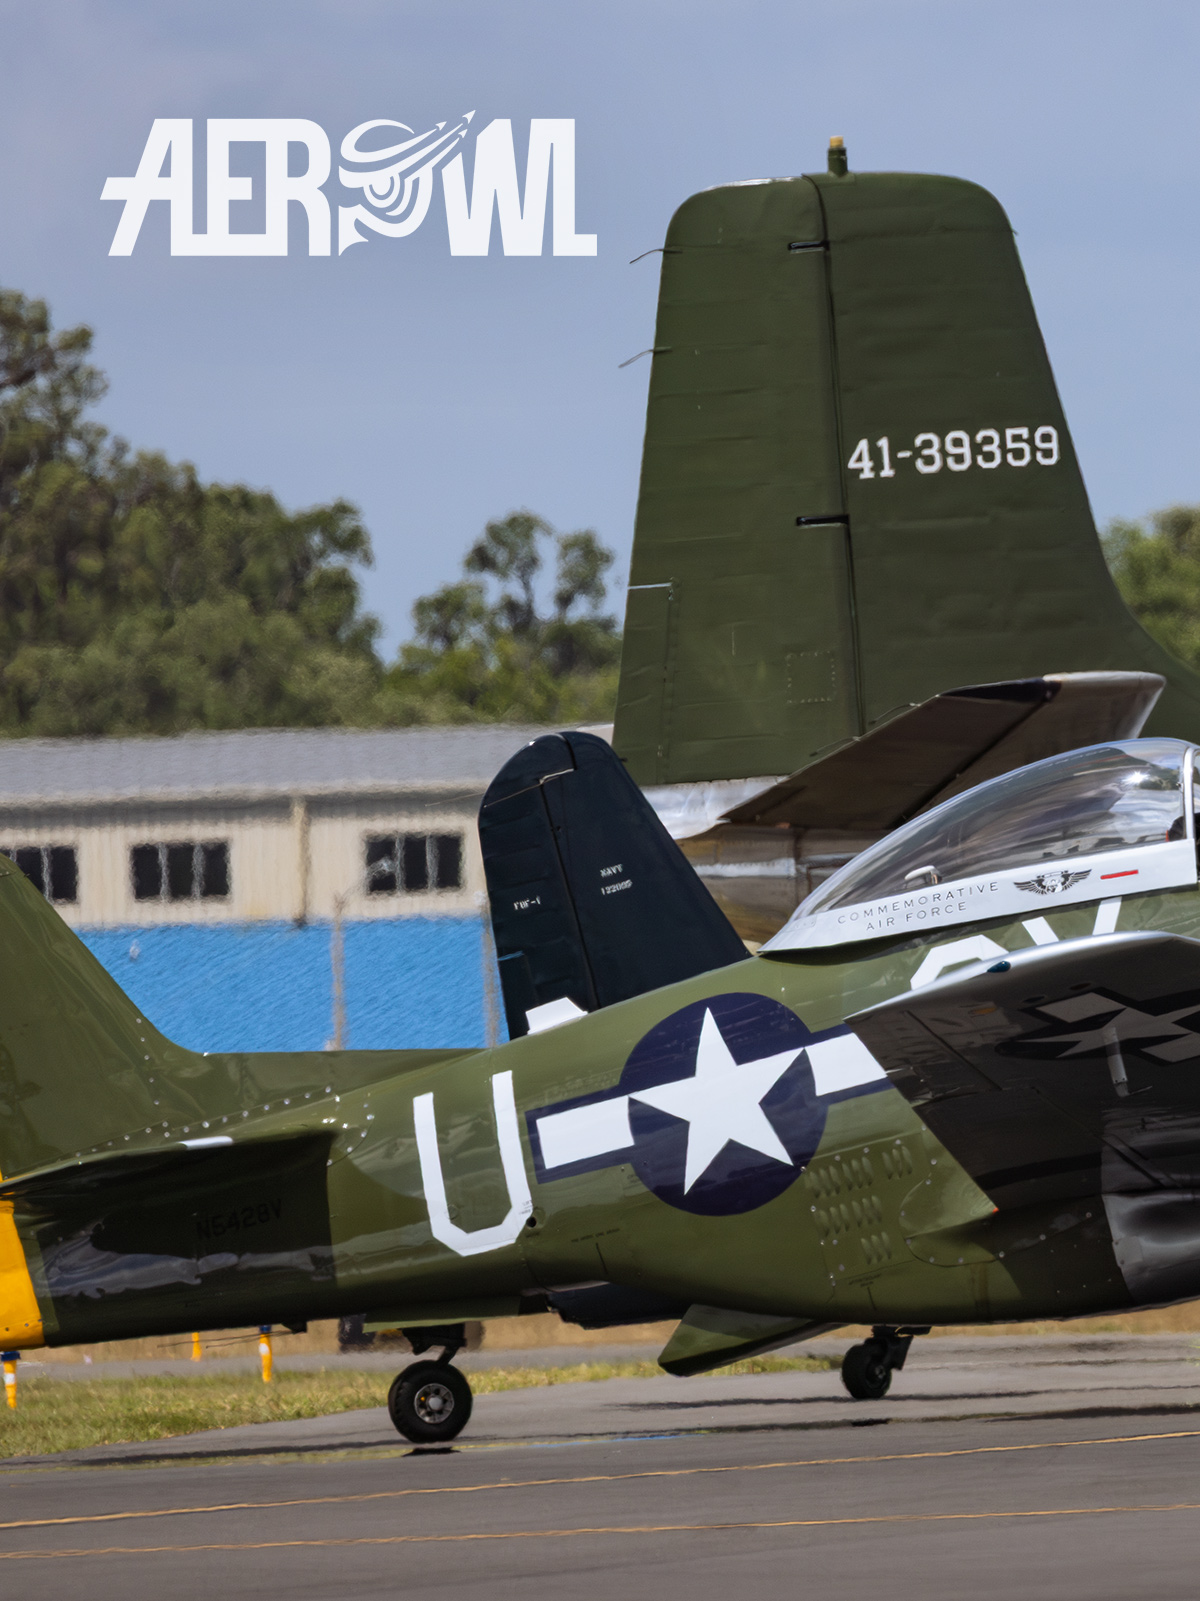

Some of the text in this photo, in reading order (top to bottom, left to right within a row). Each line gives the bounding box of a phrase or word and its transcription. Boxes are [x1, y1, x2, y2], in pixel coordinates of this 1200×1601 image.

[847, 425, 1061, 480] 41-39359
[600, 864, 623, 877] NAVY
[837, 881, 1000, 926] COMMEMORATIVE
[865, 900, 968, 932] AIR FORCE
[412, 1069, 534, 1258] U
